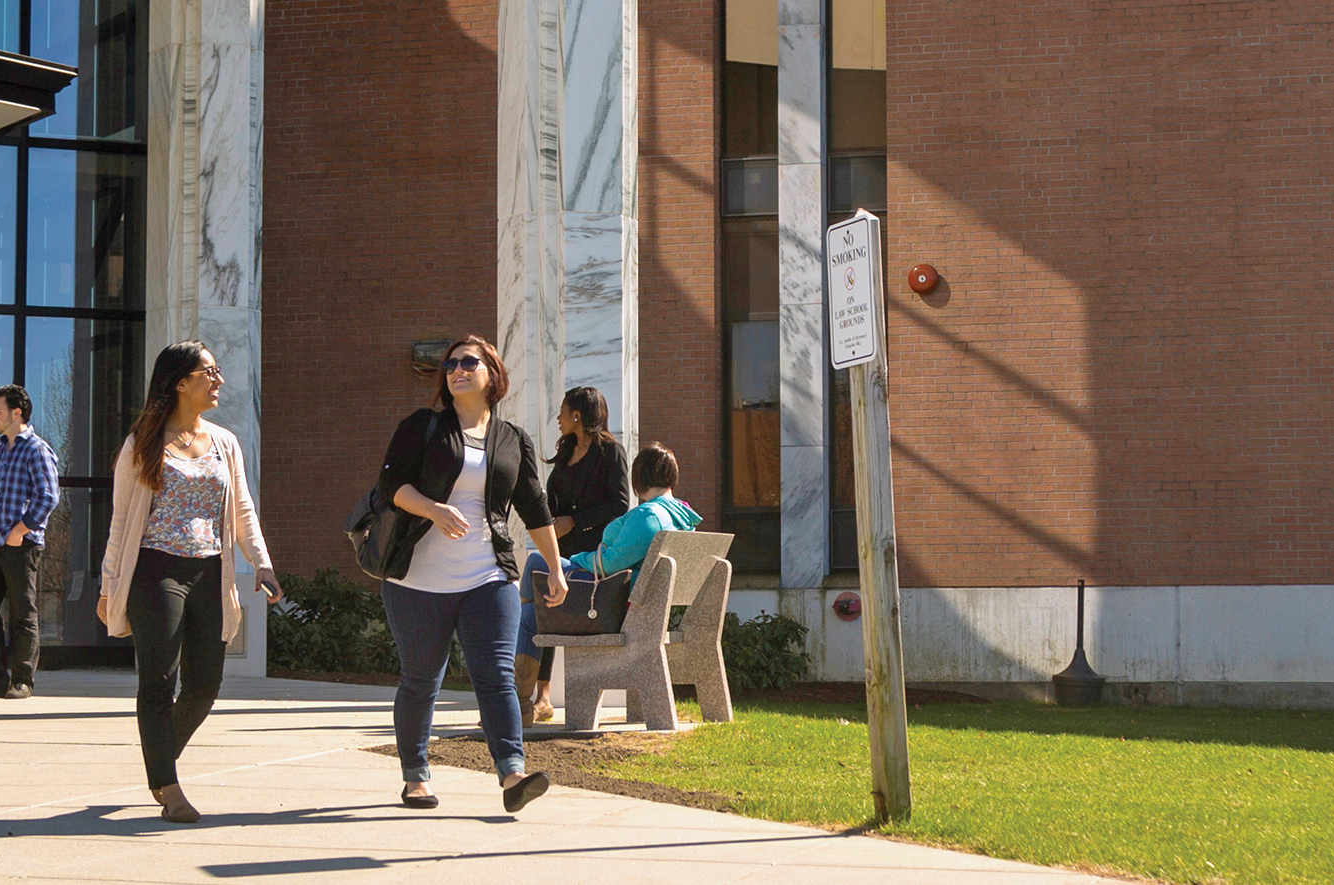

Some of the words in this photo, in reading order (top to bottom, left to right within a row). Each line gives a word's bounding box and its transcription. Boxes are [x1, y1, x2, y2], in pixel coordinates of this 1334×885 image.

[843, 234, 854, 248] NO
[832, 245, 866, 267] SMOKING
[846, 295, 855, 305] ON
[835, 309, 846, 320] LAW
[847, 303, 868, 316] SCHOOL
[839, 315, 865, 329] GROUNDS
